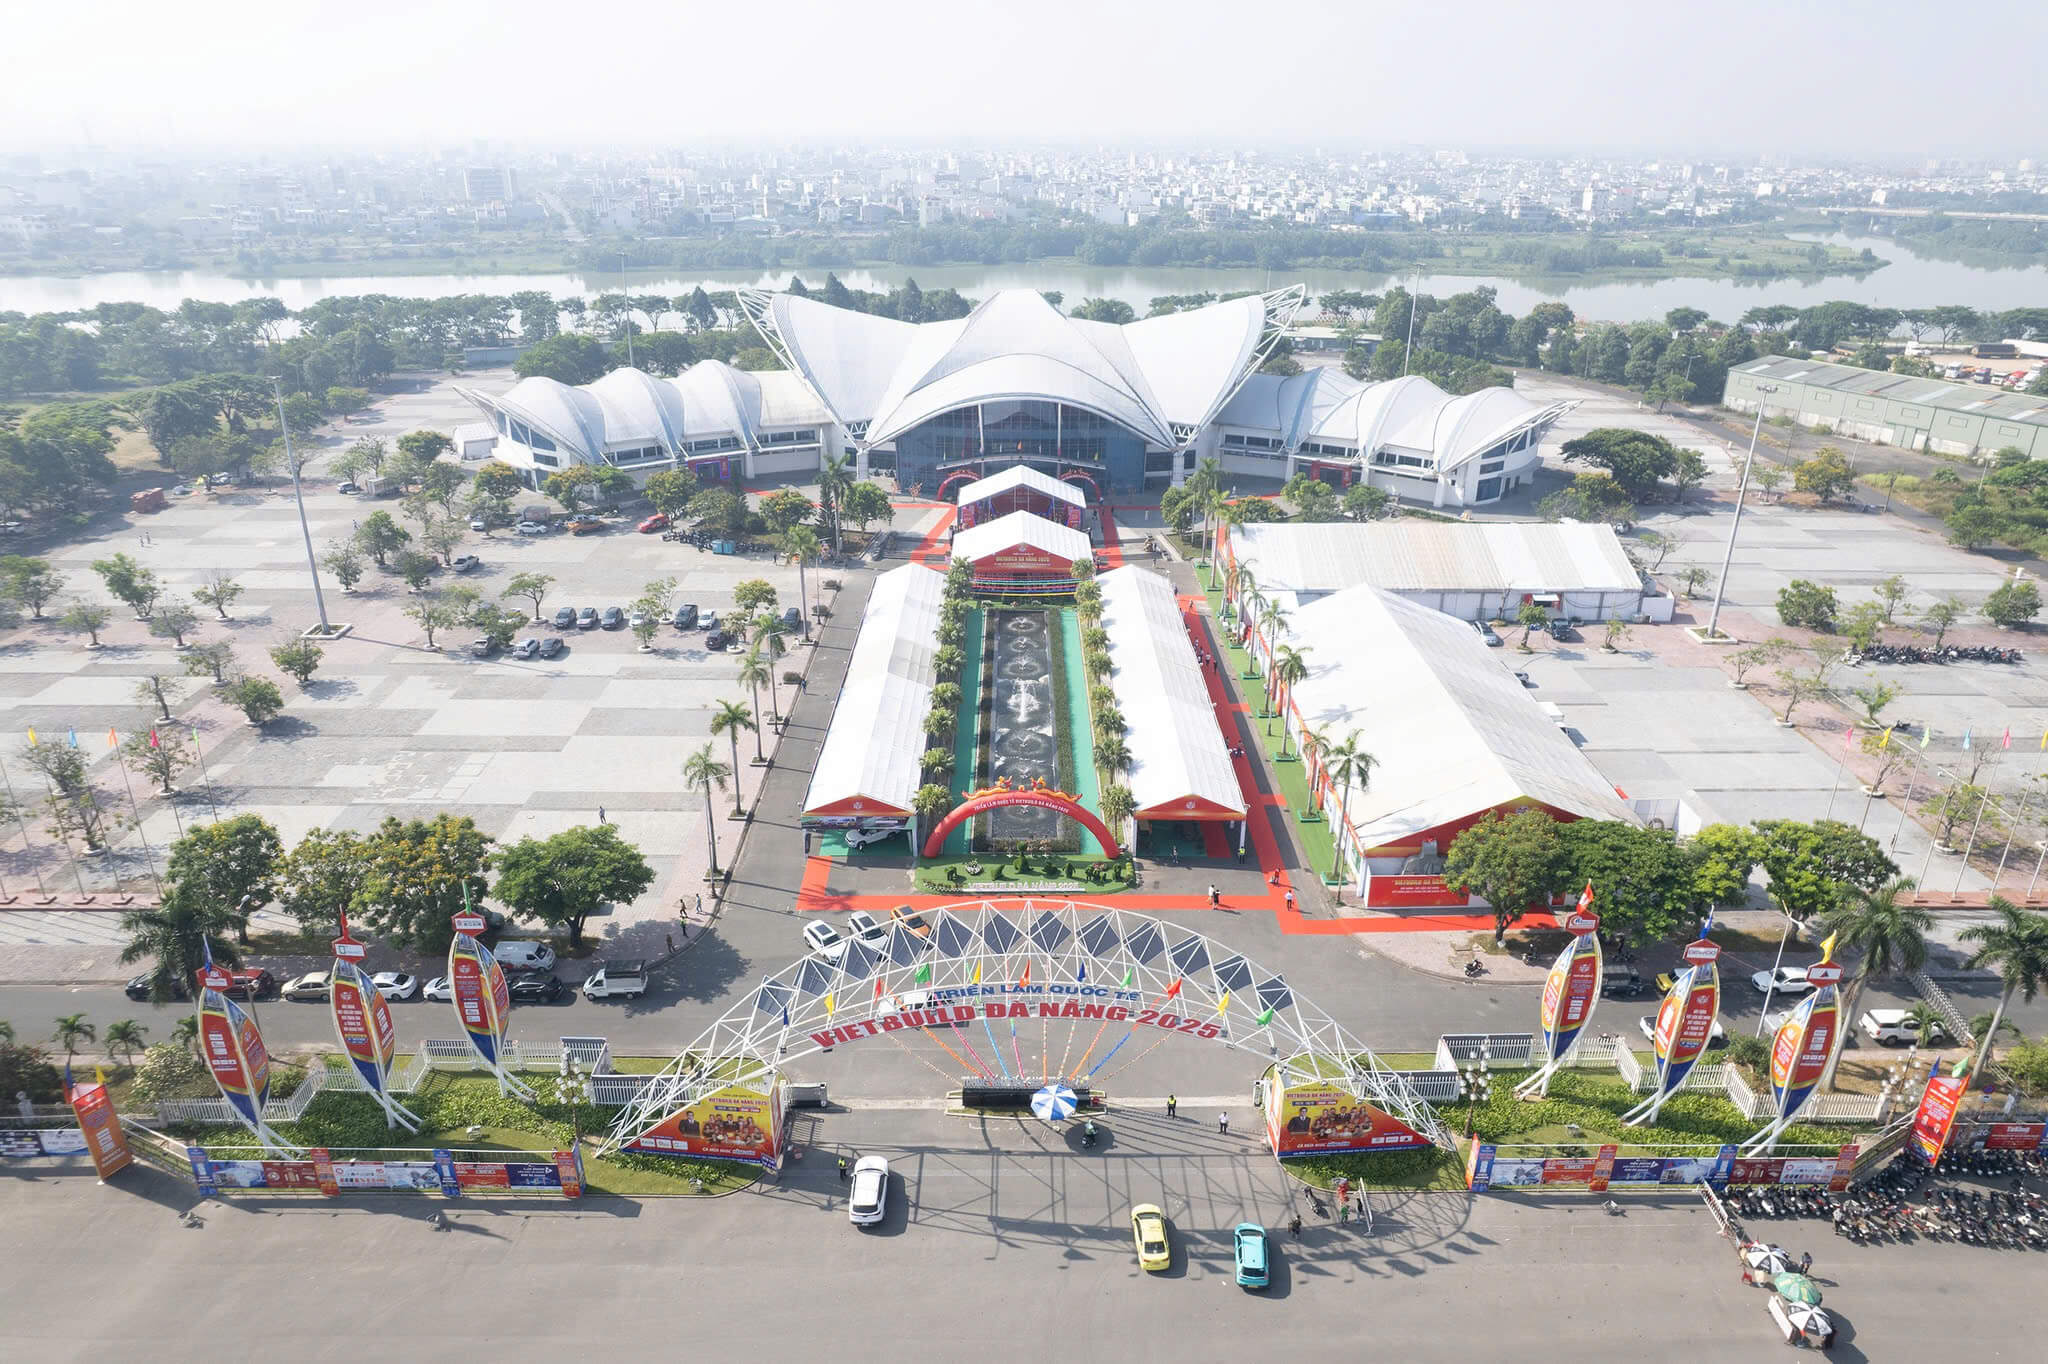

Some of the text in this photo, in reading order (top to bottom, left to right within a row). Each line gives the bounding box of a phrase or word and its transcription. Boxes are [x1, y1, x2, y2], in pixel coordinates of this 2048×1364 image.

[810, 1005, 976, 1048] VIETBUILD
[985, 999, 1030, 1018] ĐÀ
[1135, 1008, 1222, 1039] 2025
